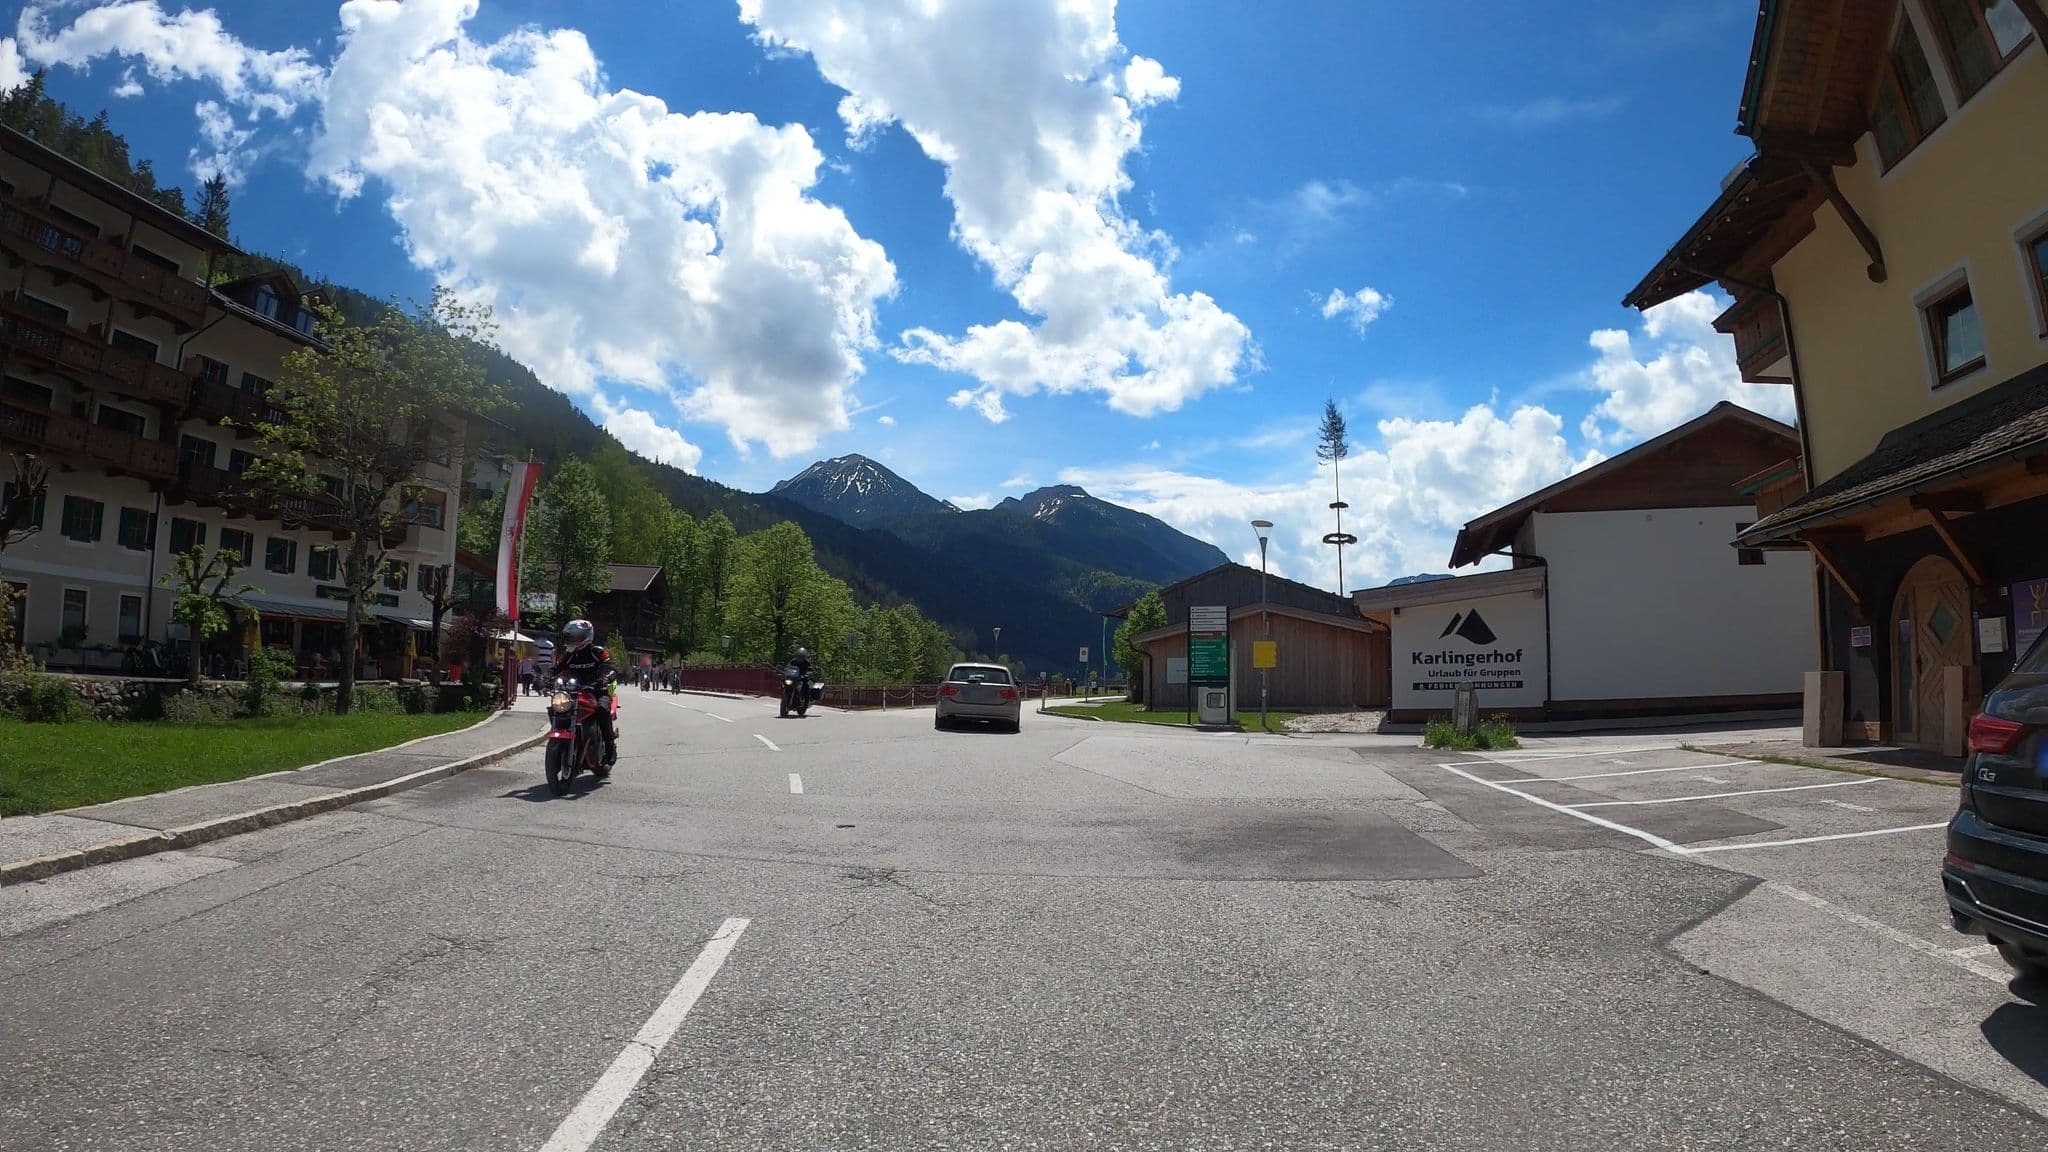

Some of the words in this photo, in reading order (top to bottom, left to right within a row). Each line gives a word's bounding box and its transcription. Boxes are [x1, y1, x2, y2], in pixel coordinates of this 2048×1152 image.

[1411, 648, 1523, 667] Karlingerhof
[1428, 669, 1461, 678] Urlaub
[1463, 669, 1478, 677] für
[1480, 668, 1521, 679] Gruppen
[1978, 767, 1996, 782] Q3
